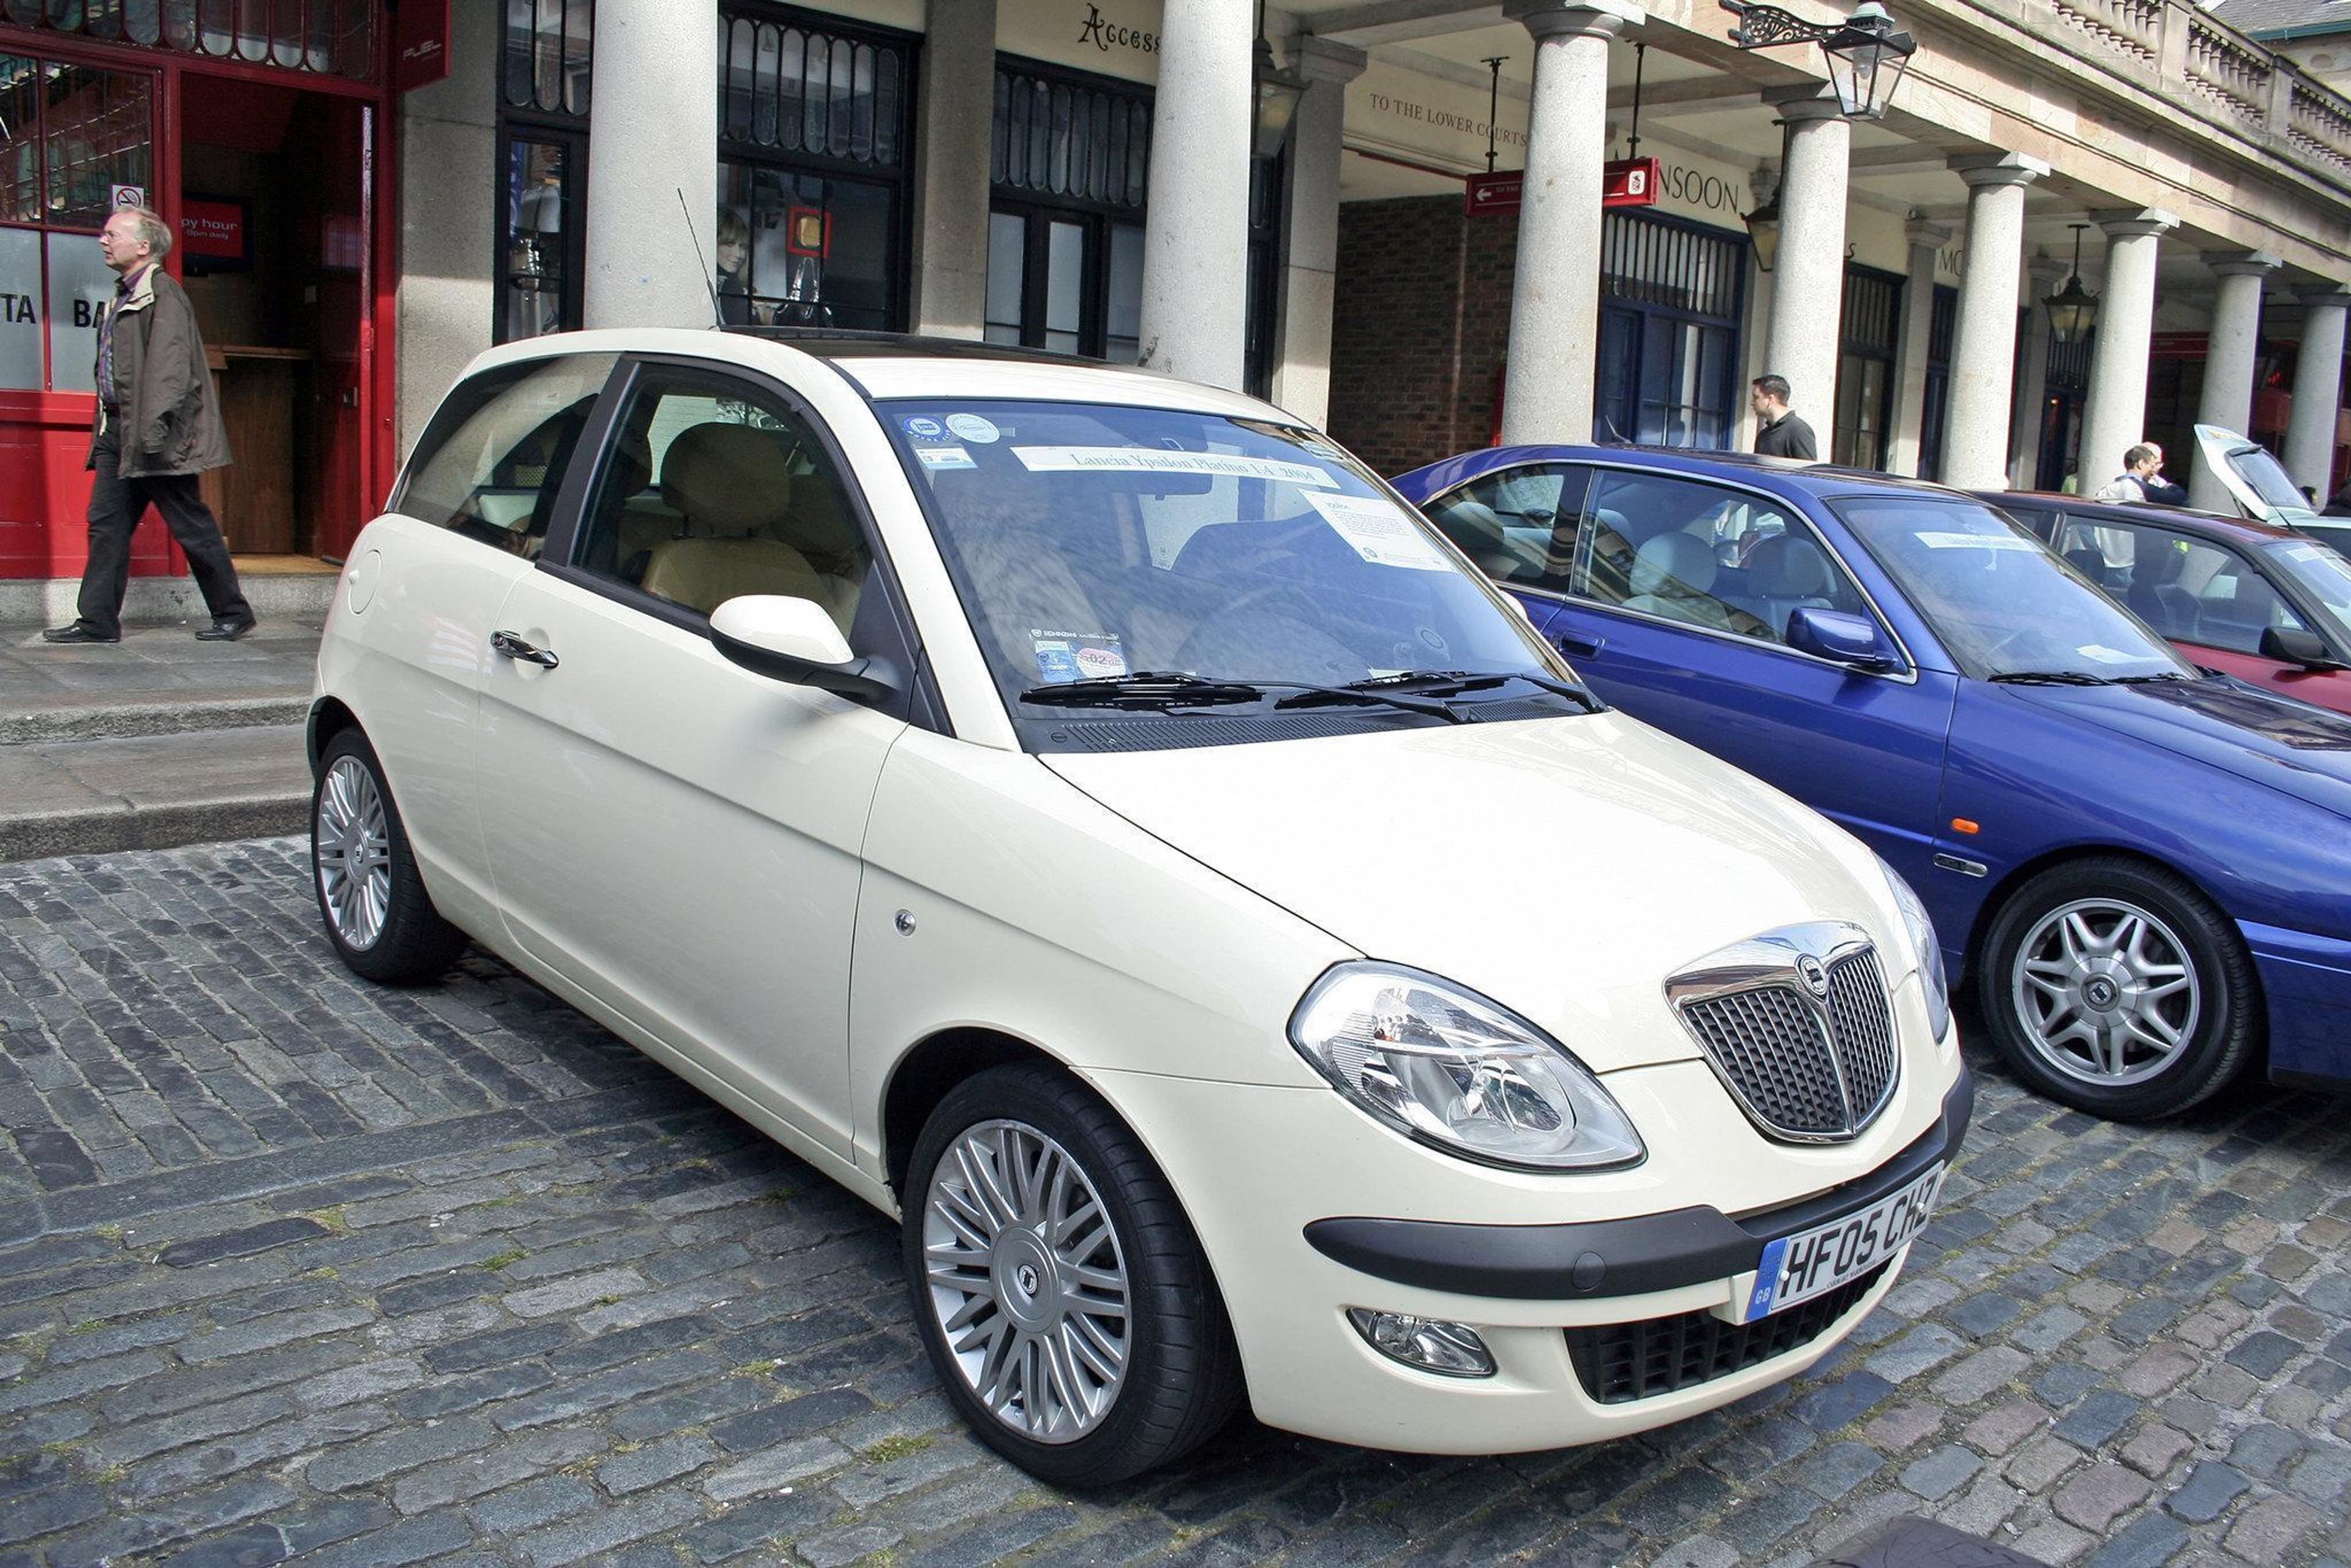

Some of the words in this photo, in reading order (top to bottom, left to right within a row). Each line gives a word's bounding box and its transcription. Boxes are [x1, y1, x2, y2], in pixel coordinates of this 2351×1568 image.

[1370, 93, 1389, 110] TO
[1393, 100, 1423, 120] THE
[1427, 109, 1474, 134] LOWER
[1476, 122, 1528, 148] COURTS
[1657, 164, 1739, 214] NSOON
[202, 217, 238, 230] hour
[1070, 453, 1130, 466] Lancia
[1130, 454, 1194, 470] Ypsilon
[1779, 1207, 1884, 1299] HF05
[1883, 1172, 1940, 1251] CHZ
[1755, 1286, 1771, 1305] GB
